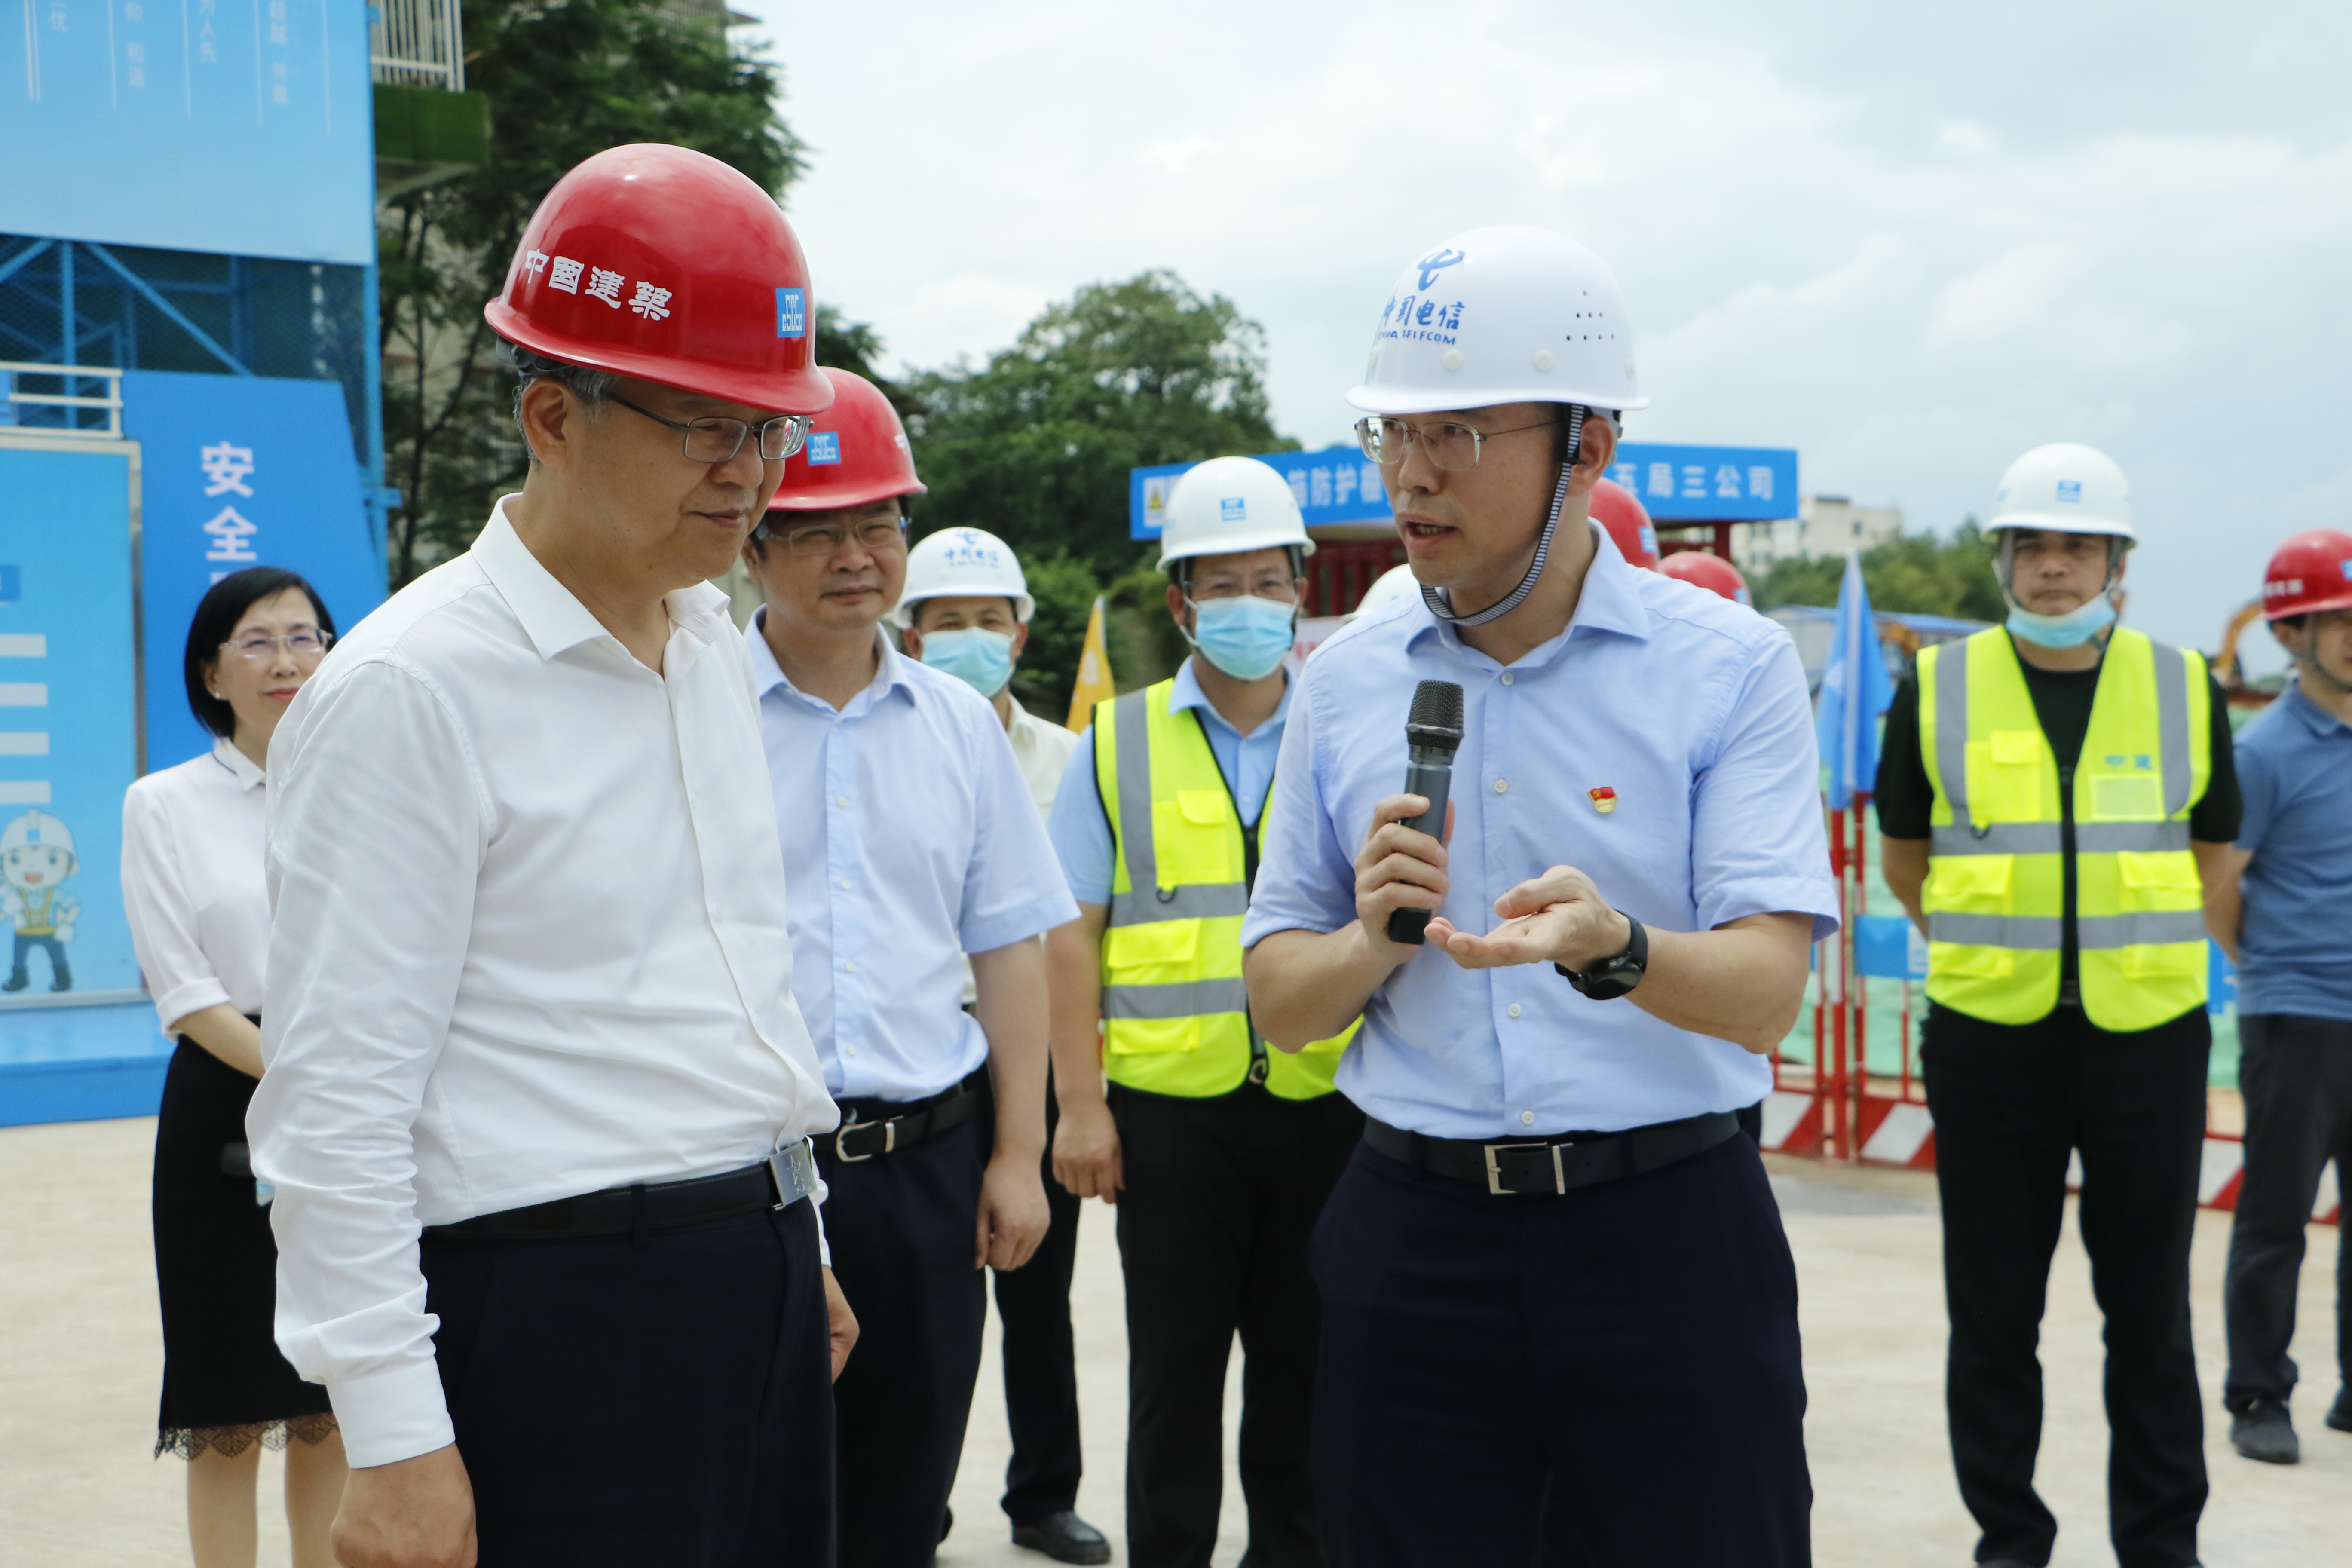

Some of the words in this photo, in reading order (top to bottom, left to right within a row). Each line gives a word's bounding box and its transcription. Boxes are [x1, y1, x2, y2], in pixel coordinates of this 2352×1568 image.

[1384, 294, 1465, 330] 中国电信
[201, 441, 258, 585] 安全
